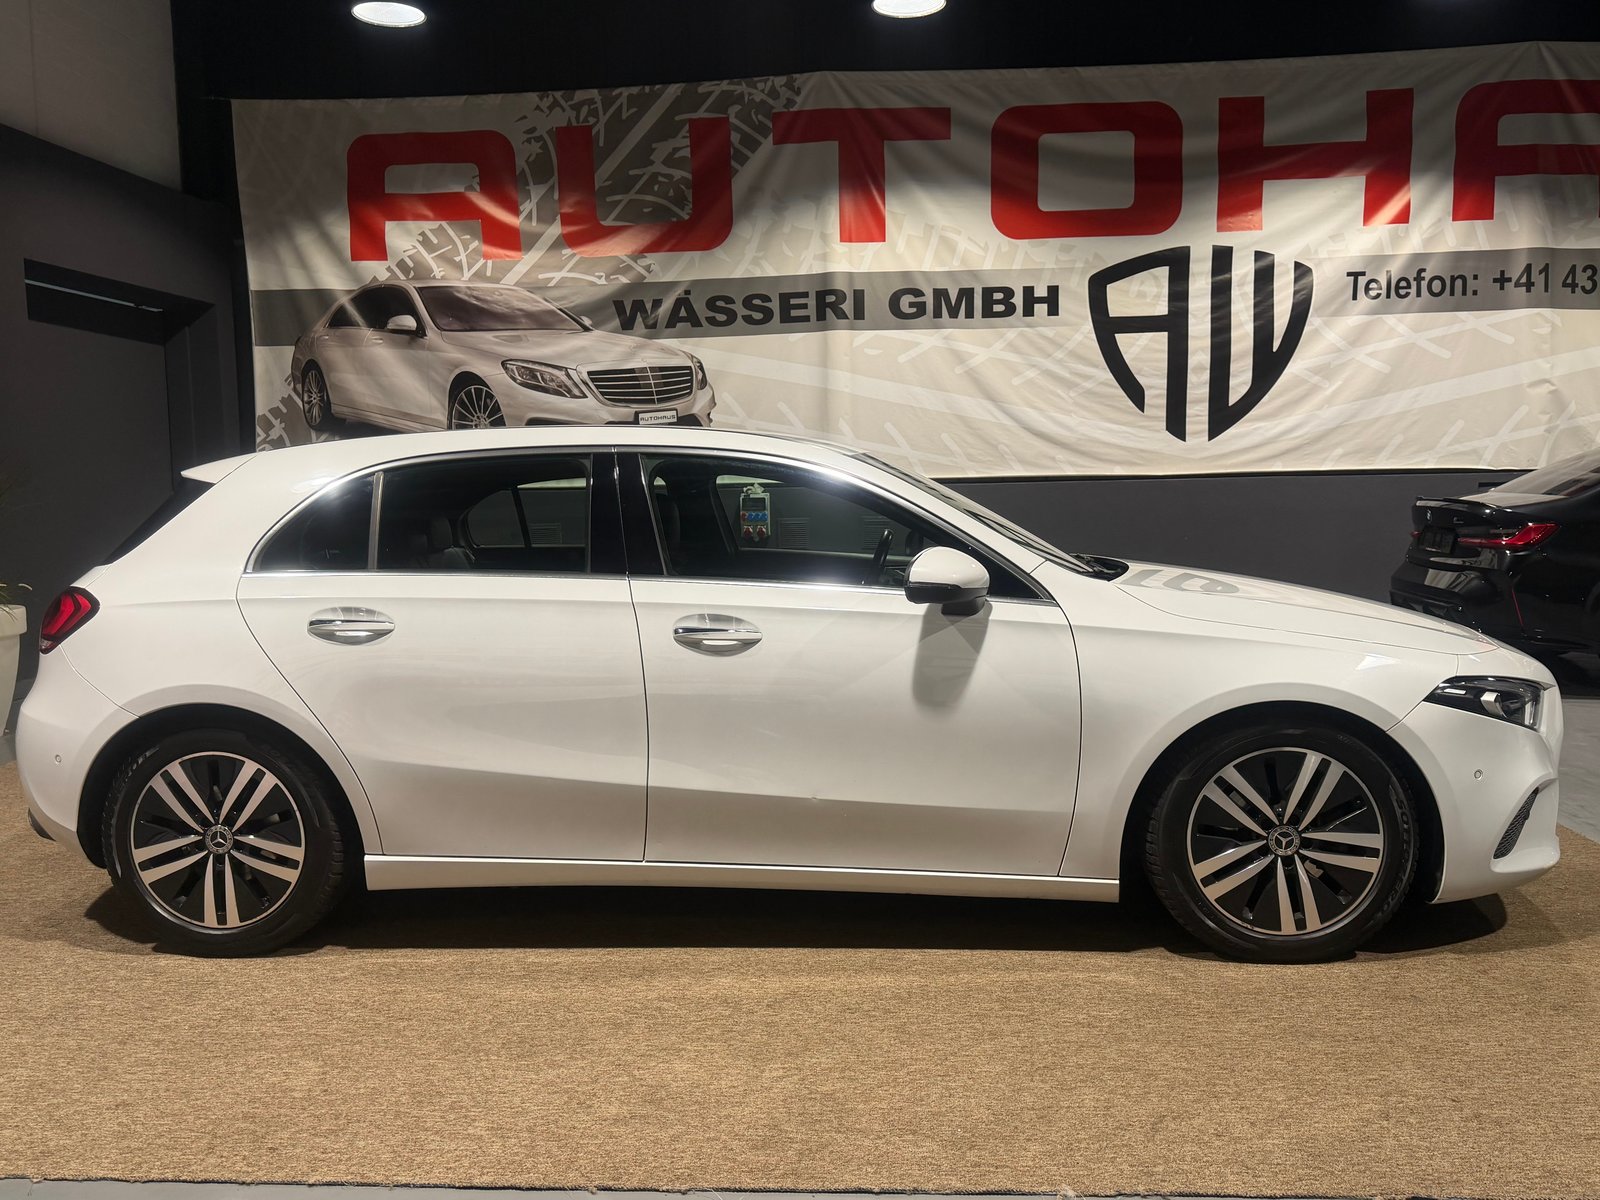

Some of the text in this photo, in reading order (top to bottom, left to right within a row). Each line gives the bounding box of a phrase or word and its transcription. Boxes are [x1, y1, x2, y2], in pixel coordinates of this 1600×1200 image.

[347, 79, 1600, 261] AUTOHA
[1346, 262, 1598, 301] Telefon: +41 43
[612, 285, 1060, 331] WÄSSERI GMBH
